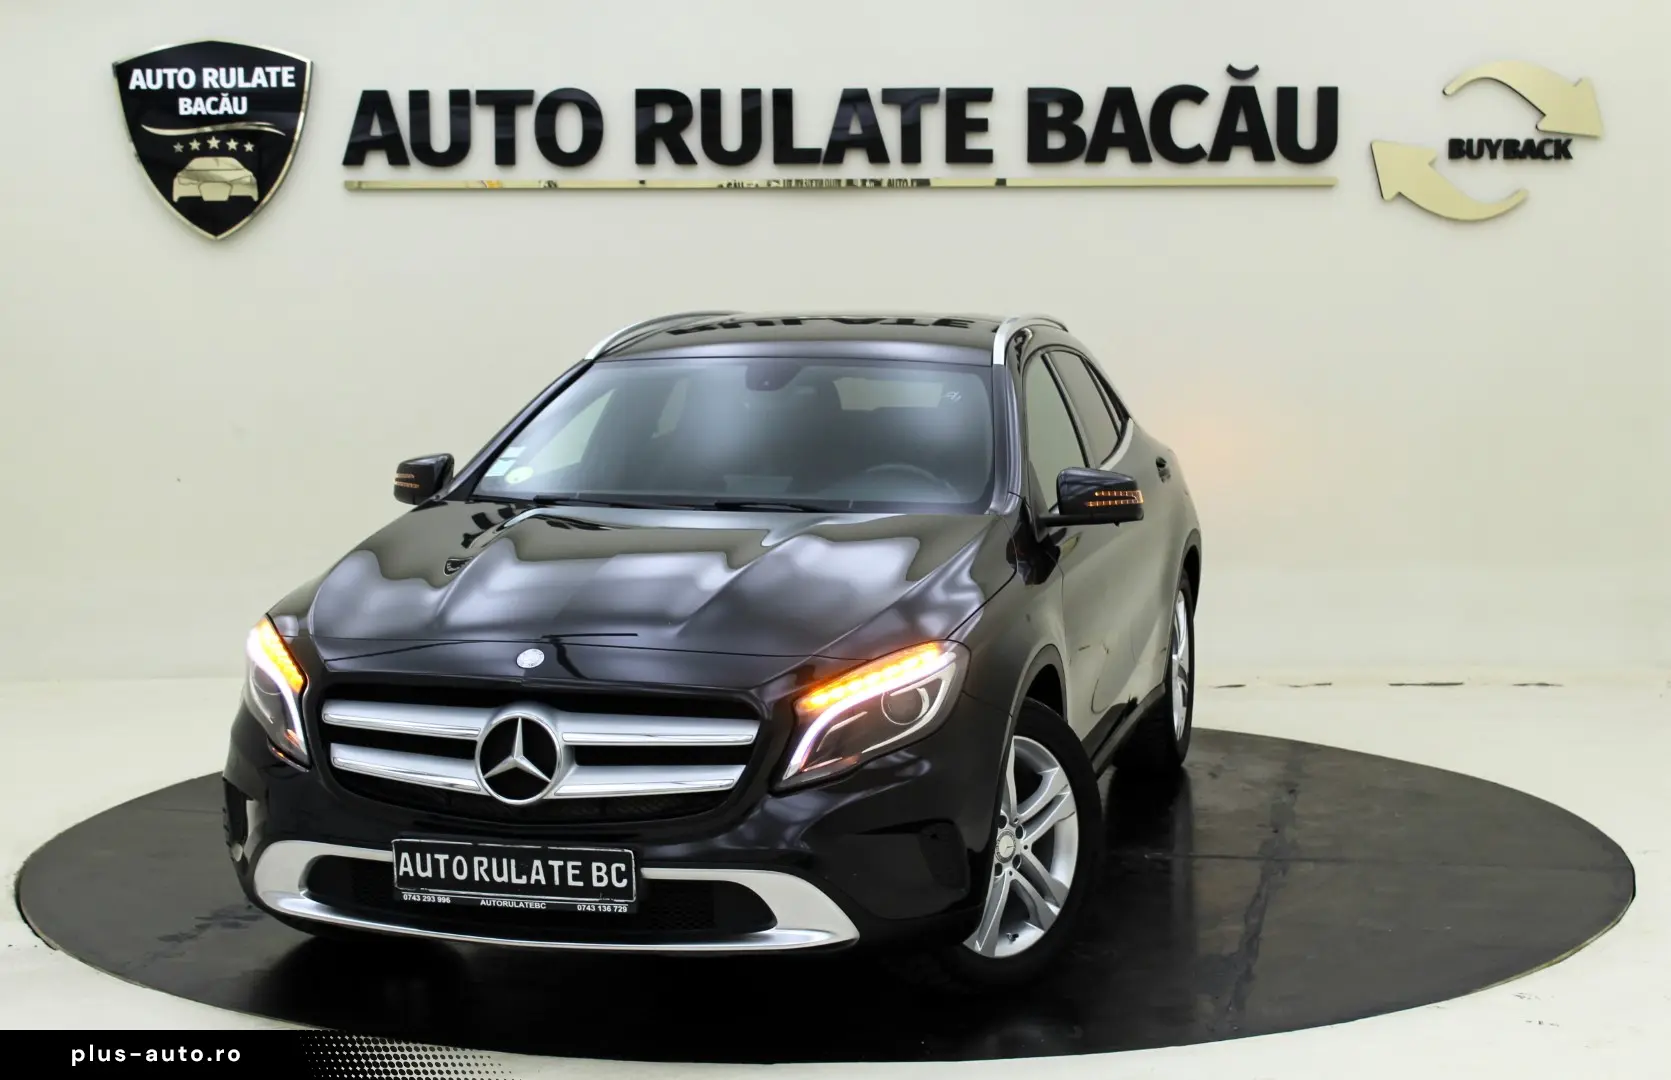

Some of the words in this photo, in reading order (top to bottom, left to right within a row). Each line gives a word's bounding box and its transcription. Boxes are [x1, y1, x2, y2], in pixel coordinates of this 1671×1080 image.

[129, 67, 196, 90] AUTO
[202, 66, 296, 89] RULATE
[178, 92, 248, 116] BACĂU
[342, 87, 604, 168] AUTO
[635, 86, 995, 167] RULATE
[1026, 64, 1339, 165] BACĂU
[1448, 137, 1573, 160] BUYBACK
[591, 861, 629, 888] BC
[403, 893, 420, 902] 0743
[422, 895, 436, 903] 293
[437, 896, 451, 904] 996
[480, 899, 546, 909] AUTORULATEBC
[577, 904, 596, 912] 0743
[598, 905, 612, 913] 136
[613, 905, 628, 913] 729
